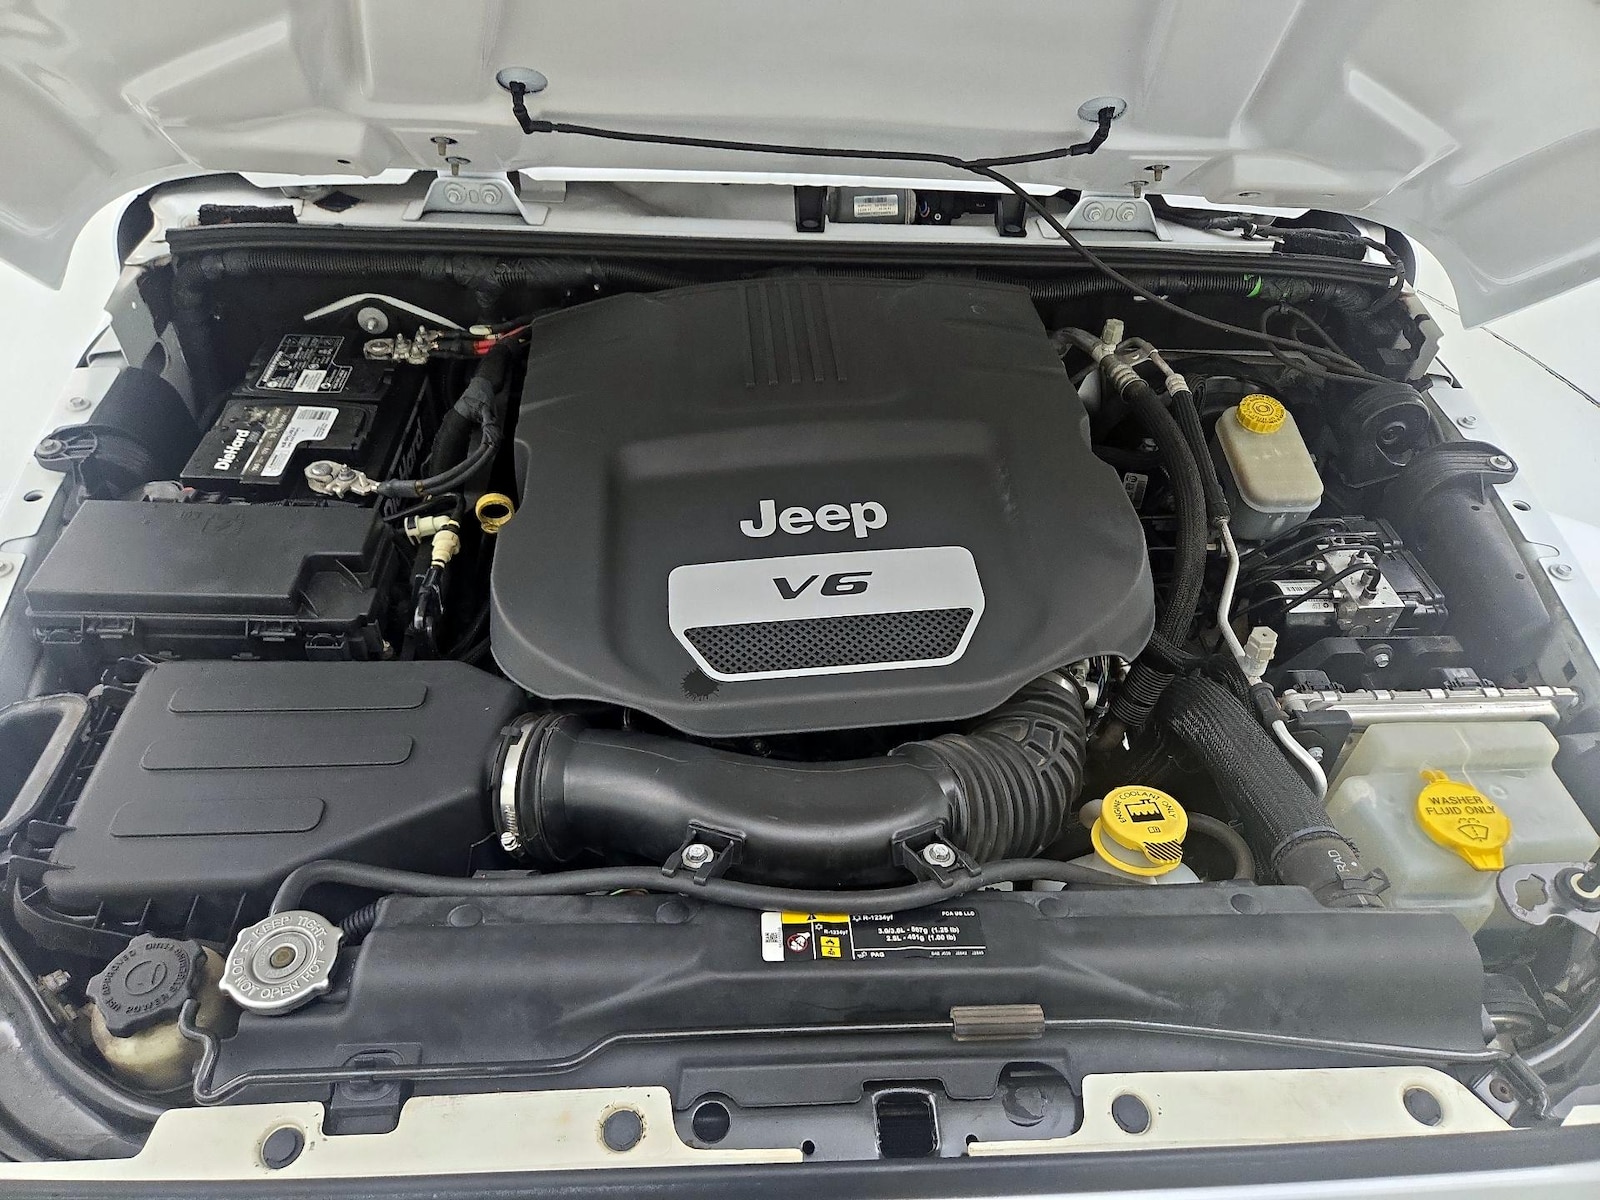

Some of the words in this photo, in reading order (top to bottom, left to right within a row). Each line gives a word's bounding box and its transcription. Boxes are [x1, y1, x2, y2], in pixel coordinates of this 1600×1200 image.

[214, 429, 251, 471] DieHard
[740, 499, 888, 538] Jeep
[772, 571, 873, 600] V6
[1119, 790, 1160, 801] COOLANT
[1428, 796, 1483, 805] WASHER
[1113, 799, 1127, 823] ENGINE
[1161, 800, 1177, 819] ONLY
[1425, 807, 1462, 815] FLUID
[1464, 805, 1496, 815] ONLY
[1327, 849, 1350, 873] RAD
[252, 916, 292, 939] KEEP
[297, 915, 328, 938] TIGHT
[102, 950, 137, 996] APPROVED
[233, 957, 245, 975] DO
[302, 958, 326, 983] HOT
[234, 976, 260, 997] NOT
[260, 982, 301, 999] OPEN
[125, 994, 170, 1014] POWER
